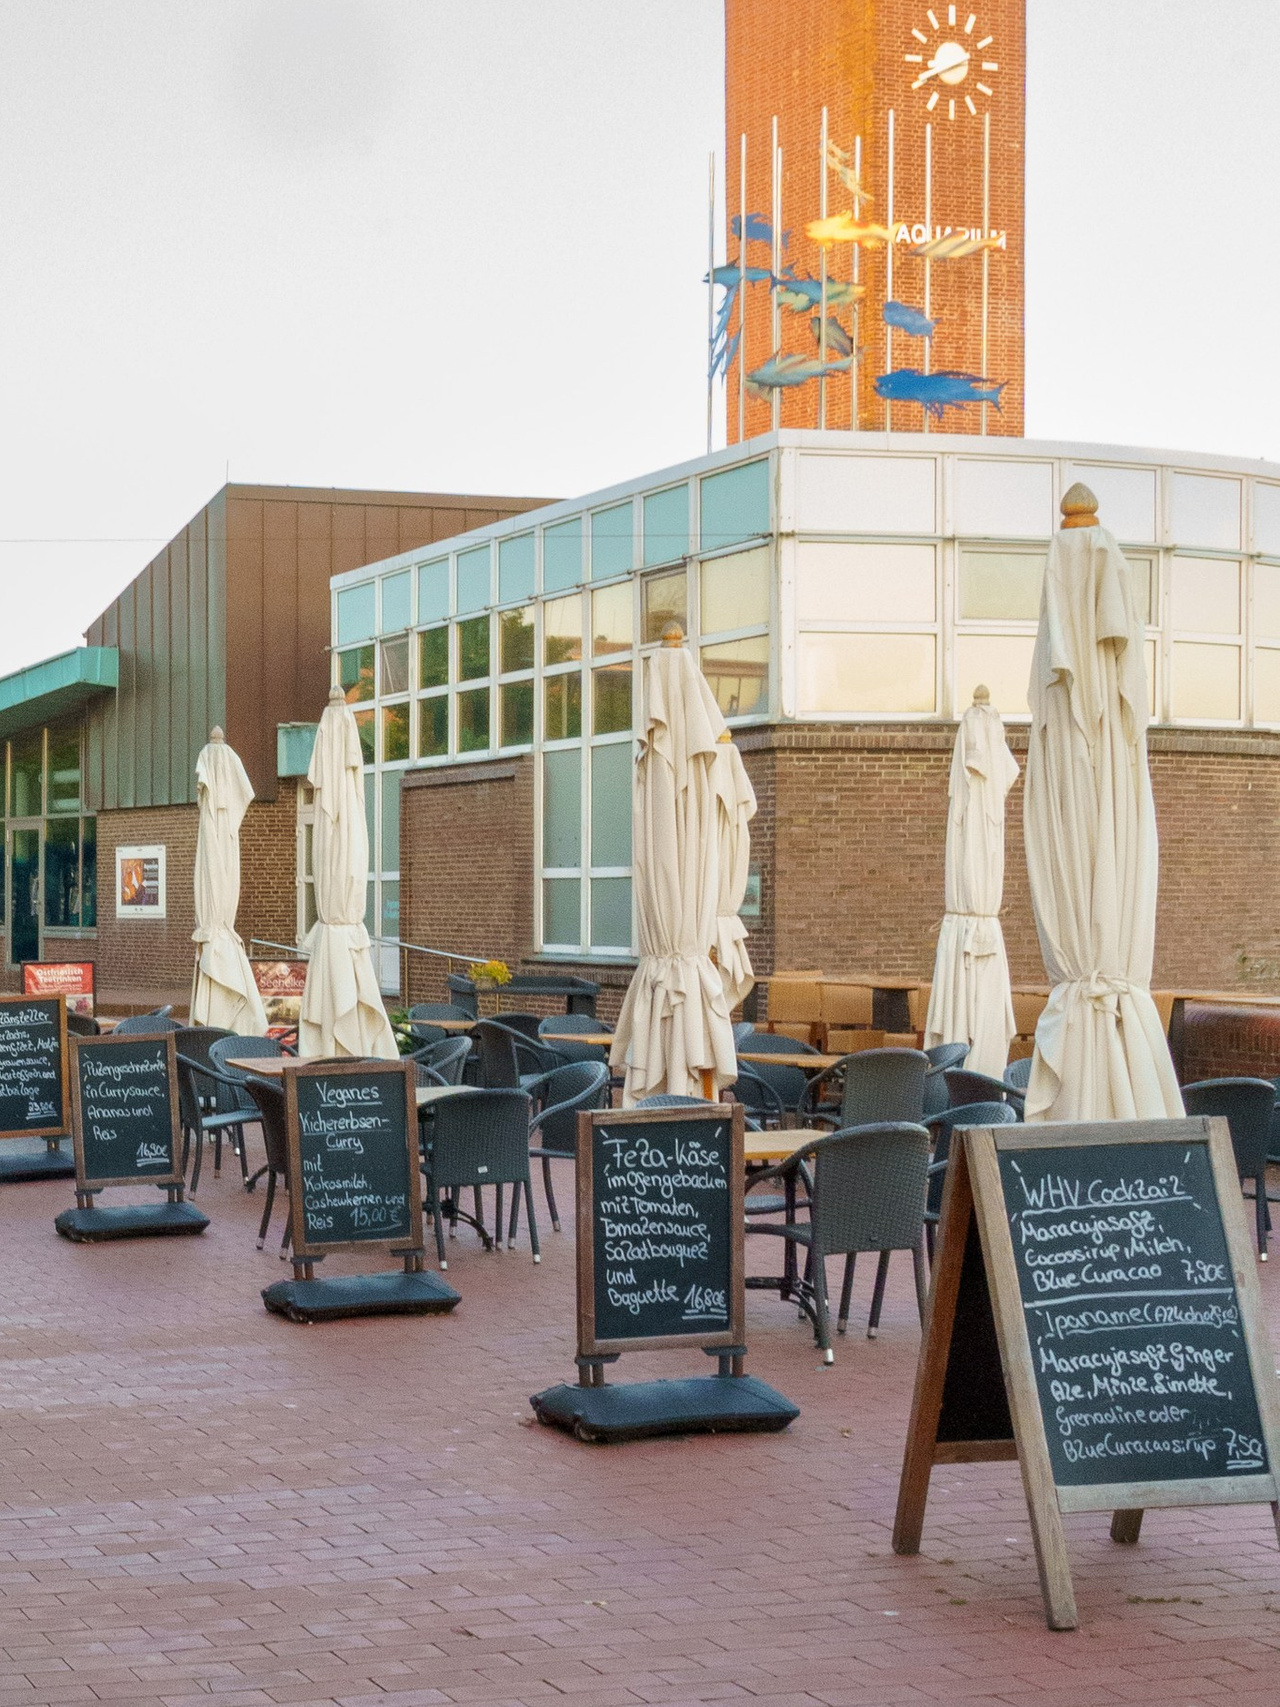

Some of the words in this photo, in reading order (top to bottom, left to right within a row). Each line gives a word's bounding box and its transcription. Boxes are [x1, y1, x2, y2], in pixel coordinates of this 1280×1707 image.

[85, 1085, 98, 1098] in
[316, 1081, 380, 1108] Veganes
[87, 1105, 131, 1120] Ananas
[132, 1105, 154, 1117] und
[299, 1110, 390, 1132] Kichererbsen-
[92, 1126, 117, 1141] Reis
[326, 1133, 364, 1154] Curry
[303, 1153, 323, 1172] mit
[305, 1191, 382, 1210] Cashewkernen
[385, 1193, 405, 1206] und
[1020, 1174, 1080, 1208] WHV
[1087, 1175, 1186, 1205] Cocktail
[600, 1195, 631, 1215] mit
[629, 1197, 699, 1218] Tomaten,
[307, 1213, 333, 1230] Reis
[600, 1216, 711, 1242] Tomatensauce,
[605, 1238, 708, 1268] Salatbouquet
[606, 1267, 637, 1285] und
[1032, 1268, 1080, 1292] Blue
[1081, 1263, 1163, 1284] Curacao
[607, 1279, 680, 1315] Baguette
[1169, 1342, 1235, 1373] Ginger
[1055, 1405, 1146, 1436] Grenadine
[1148, 1405, 1191, 1423] oder
